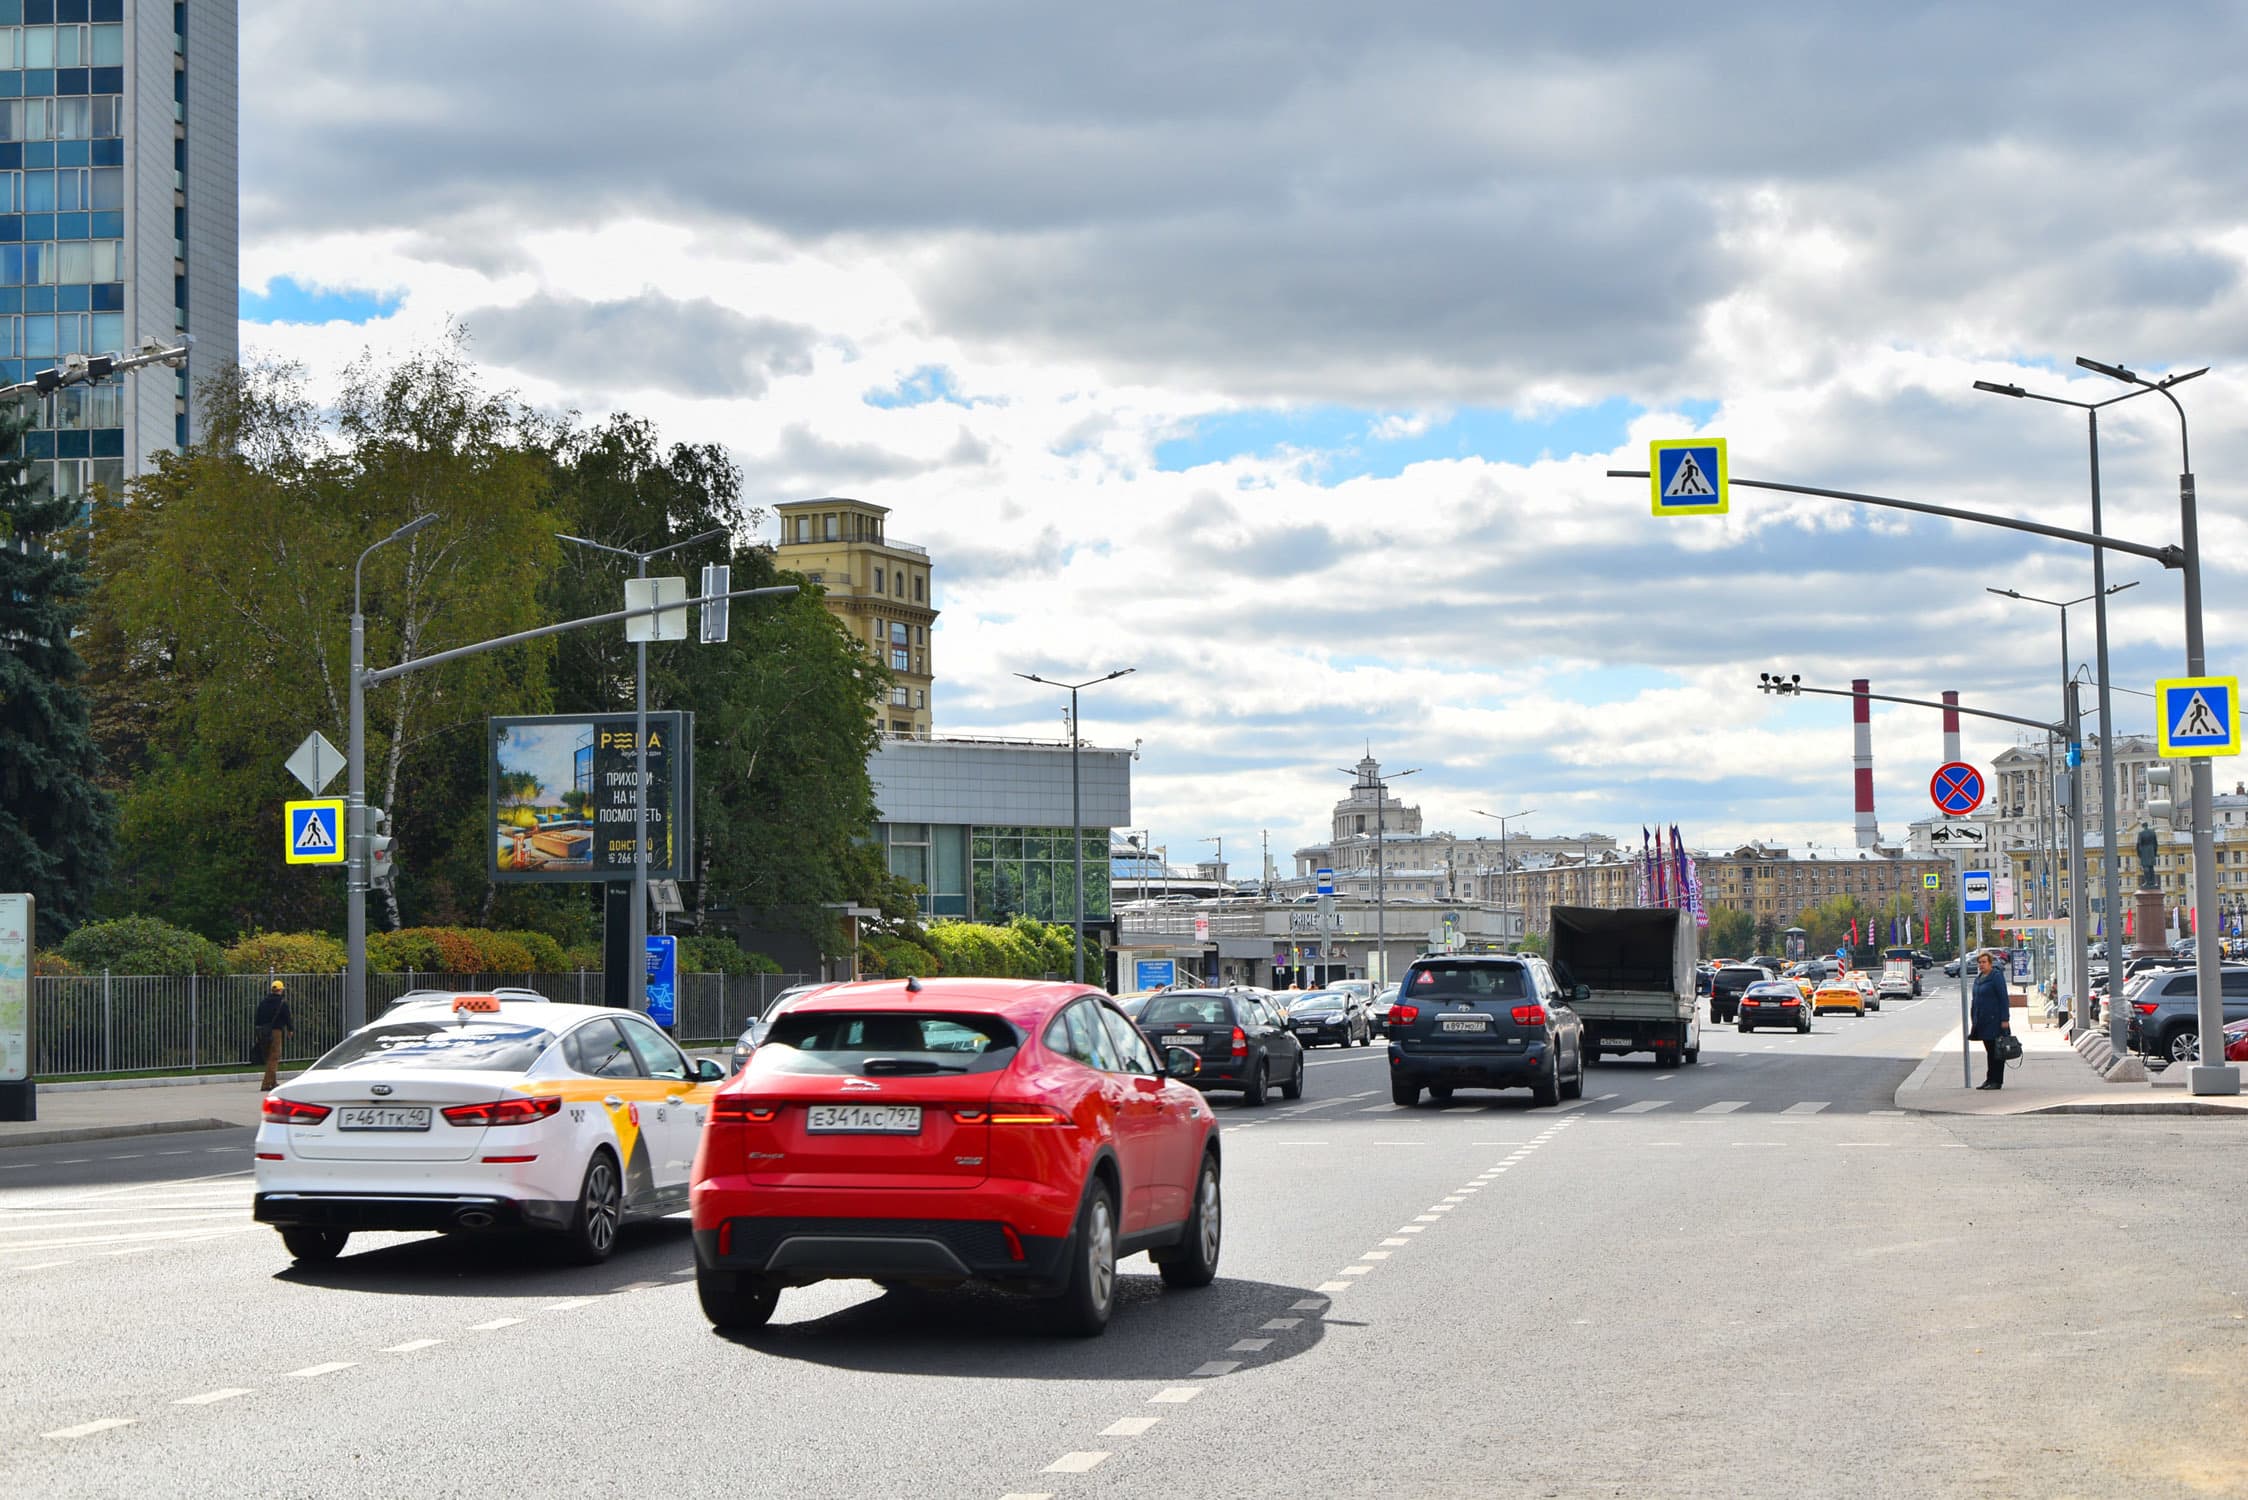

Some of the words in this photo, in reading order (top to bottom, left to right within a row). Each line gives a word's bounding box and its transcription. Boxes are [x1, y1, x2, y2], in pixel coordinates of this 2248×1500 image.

[606, 772, 653, 787] ПРИХОИ
[613, 790, 627, 805] НА
[599, 808, 662, 823] ПОСМОТЕТЬ
[608, 837, 653, 851] ДОНСТЙ
